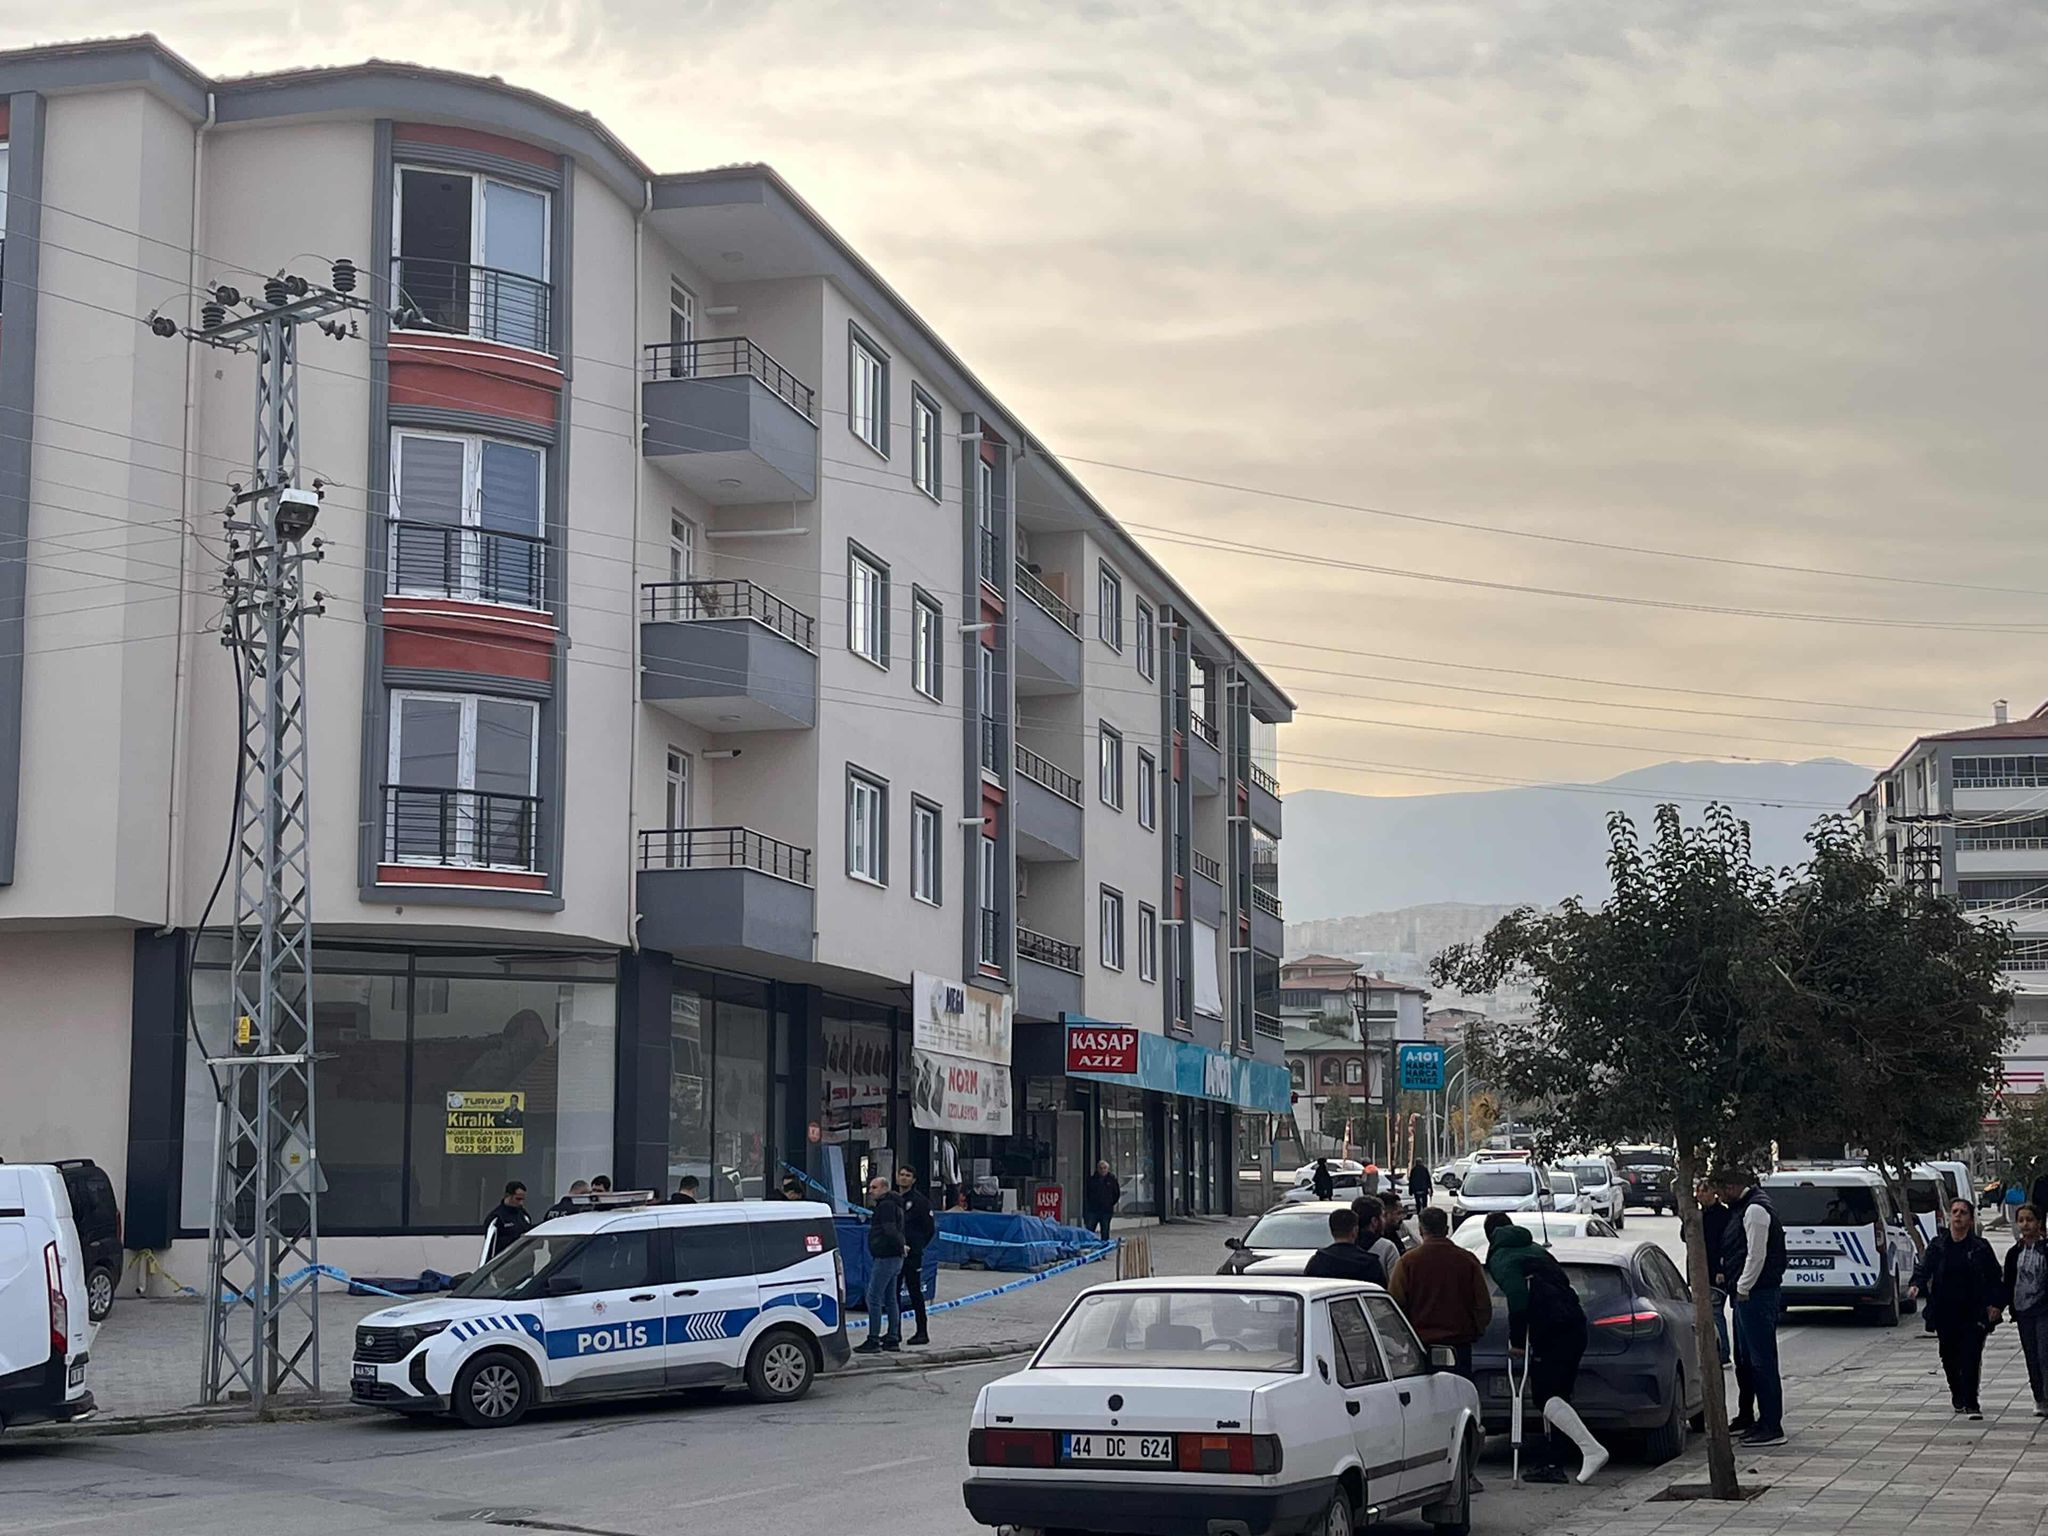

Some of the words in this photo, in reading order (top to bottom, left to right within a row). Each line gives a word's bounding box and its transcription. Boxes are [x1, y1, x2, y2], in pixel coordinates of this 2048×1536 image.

[1072, 1032, 1134, 1051] KASAP
[1078, 1055, 1123, 1067] AZİZ
[1405, 1061, 1438, 1070] HARCA
[1405, 1069, 1438, 1078] HARCA
[948, 1066, 978, 1096] NORM
[464, 1097, 505, 1105] TURYAP
[447, 1112, 496, 1127] Kiralık
[476, 1136, 493, 1144] 687
[494, 1136, 514, 1144] 1591
[1037, 1192, 1059, 1207] KASAP
[806, 1235, 820, 1245] 112
[1788, 1258, 1800, 1266] 44
[1801, 1258, 1809, 1266] A
[1796, 1271, 1825, 1283] POLİS
[577, 1321, 648, 1353] POLİS
[1072, 1437, 1091, 1457] 44
[1106, 1437, 1126, 1457] DC
[1140, 1438, 1170, 1459] 624
